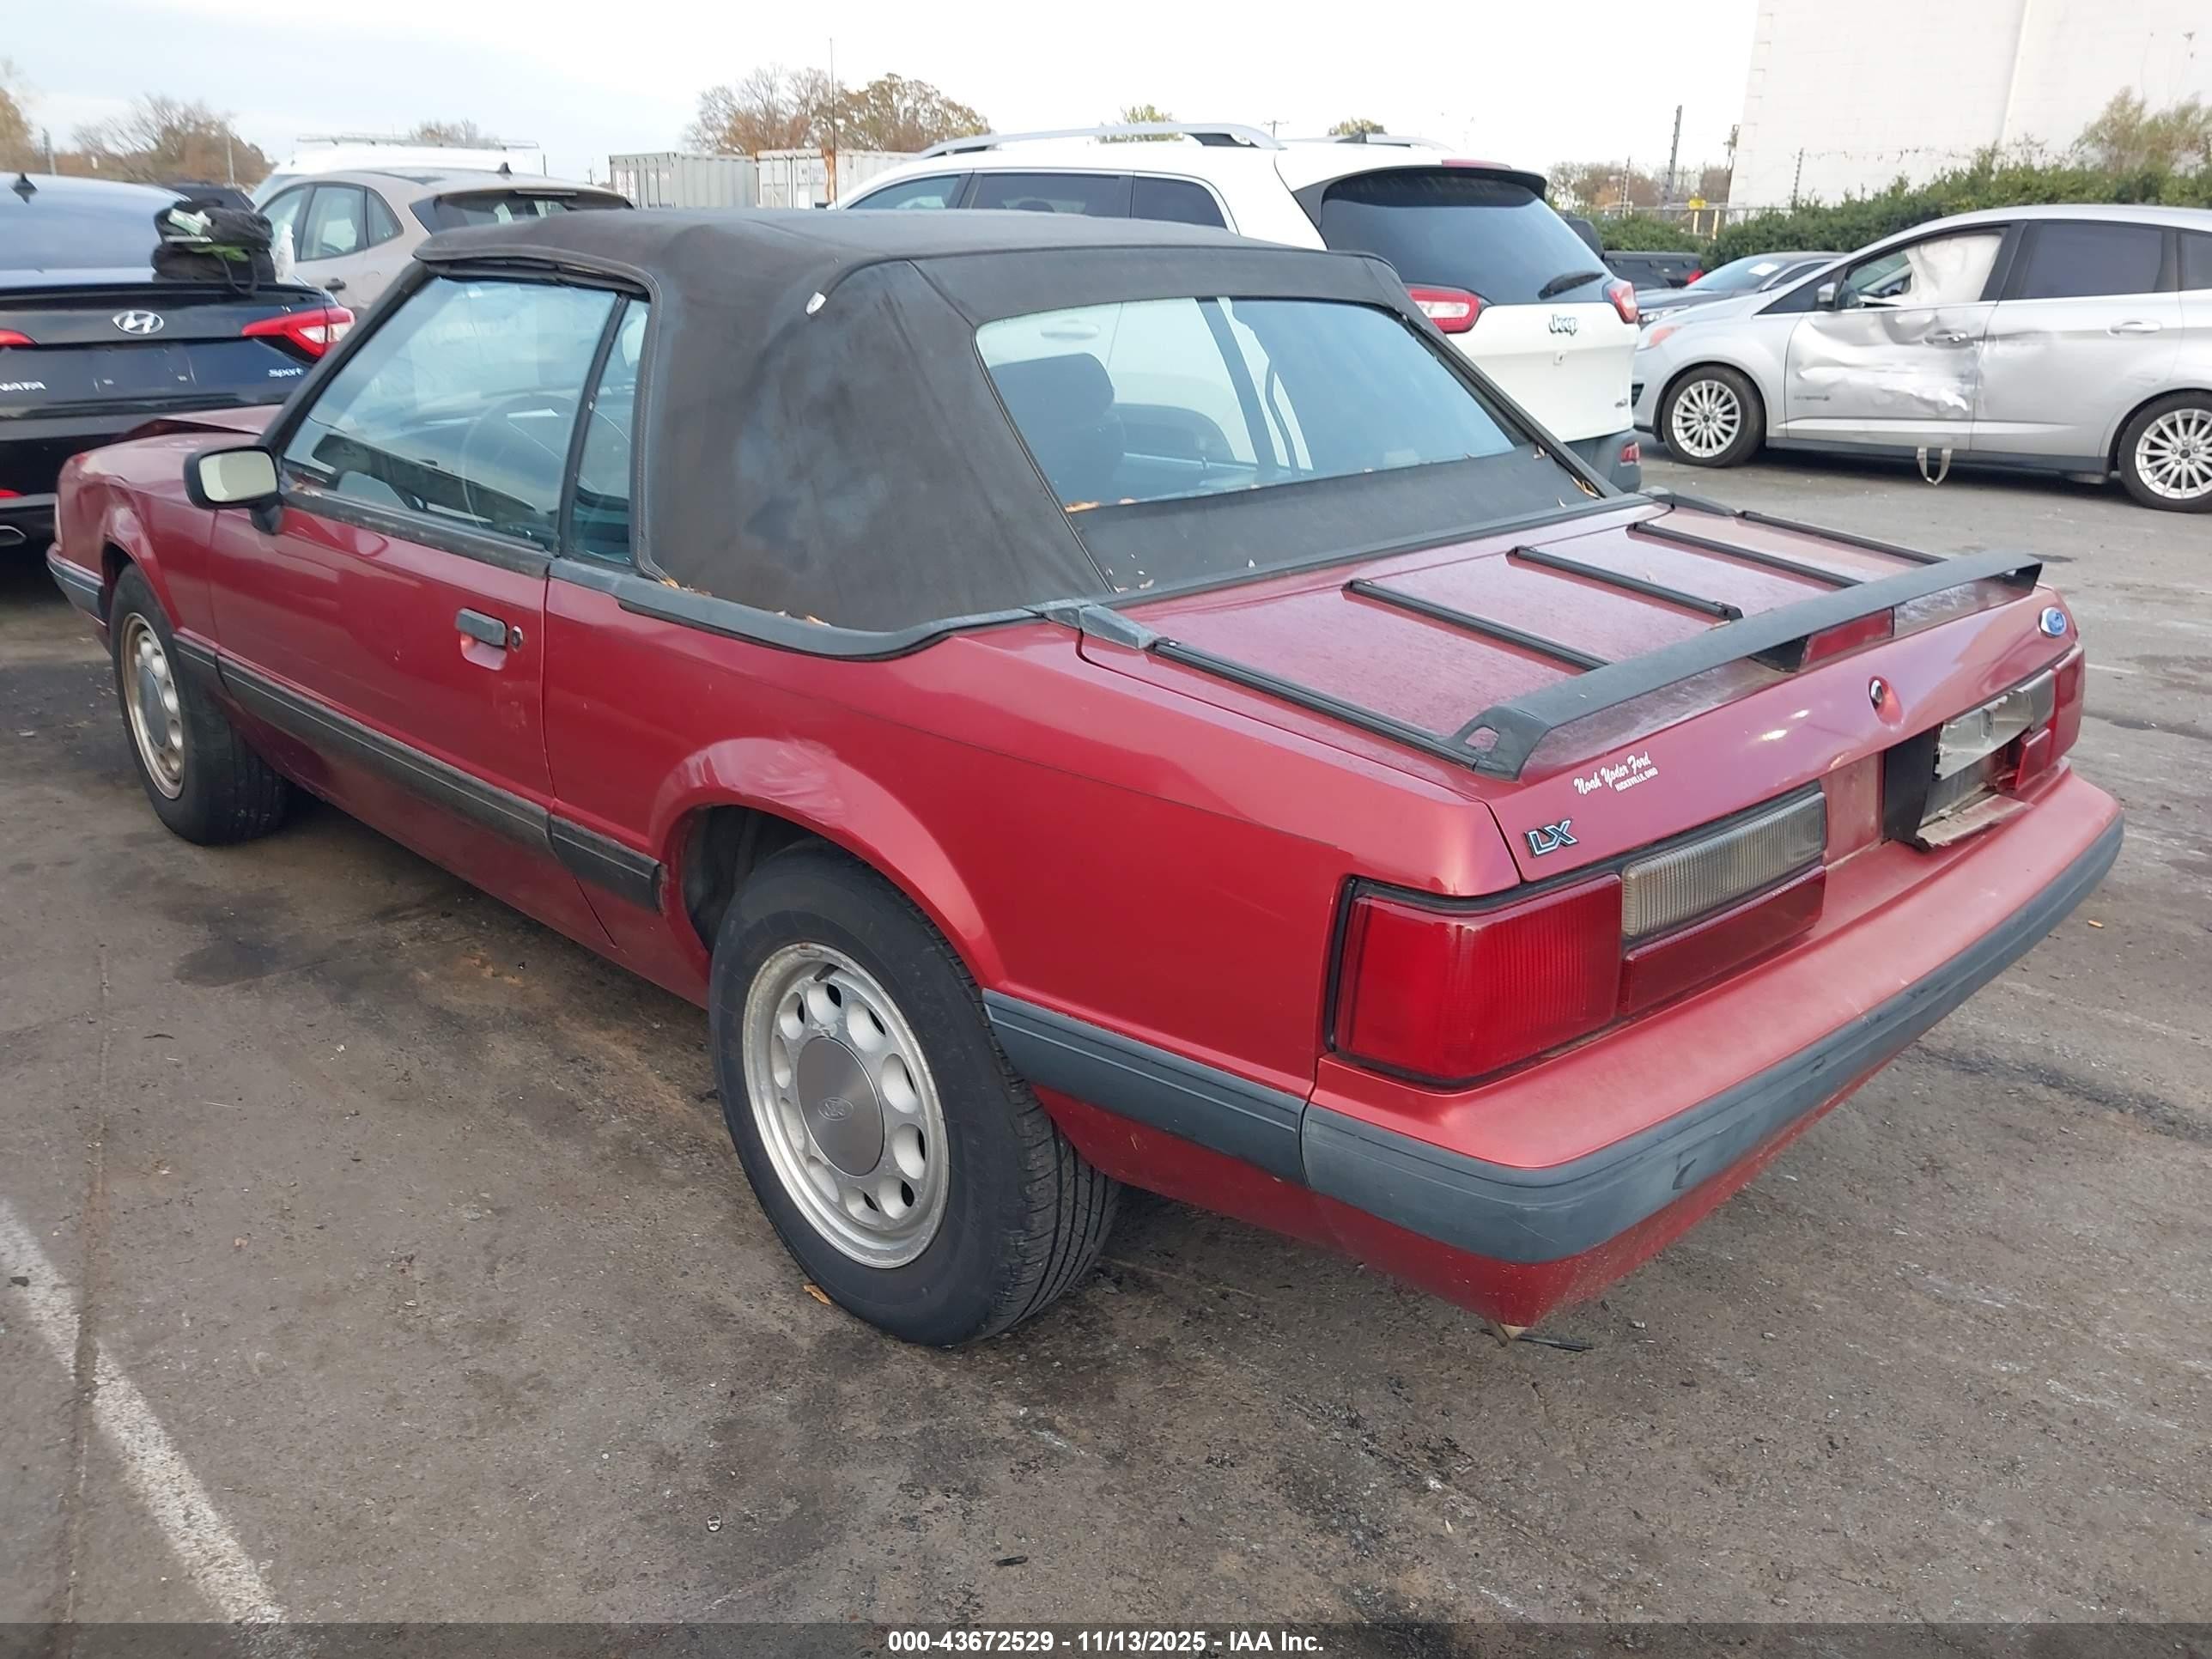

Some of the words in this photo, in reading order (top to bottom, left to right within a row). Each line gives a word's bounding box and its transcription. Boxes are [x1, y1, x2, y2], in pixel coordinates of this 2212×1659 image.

[1548, 314, 1579, 337] Jeep
[1573, 772, 1602, 795] Noah
[1600, 763, 1630, 788] Yoder
[1627, 750, 1652, 775] Ford
[1644, 767, 1659, 779] OHIO
[1525, 818, 1579, 857] LX
